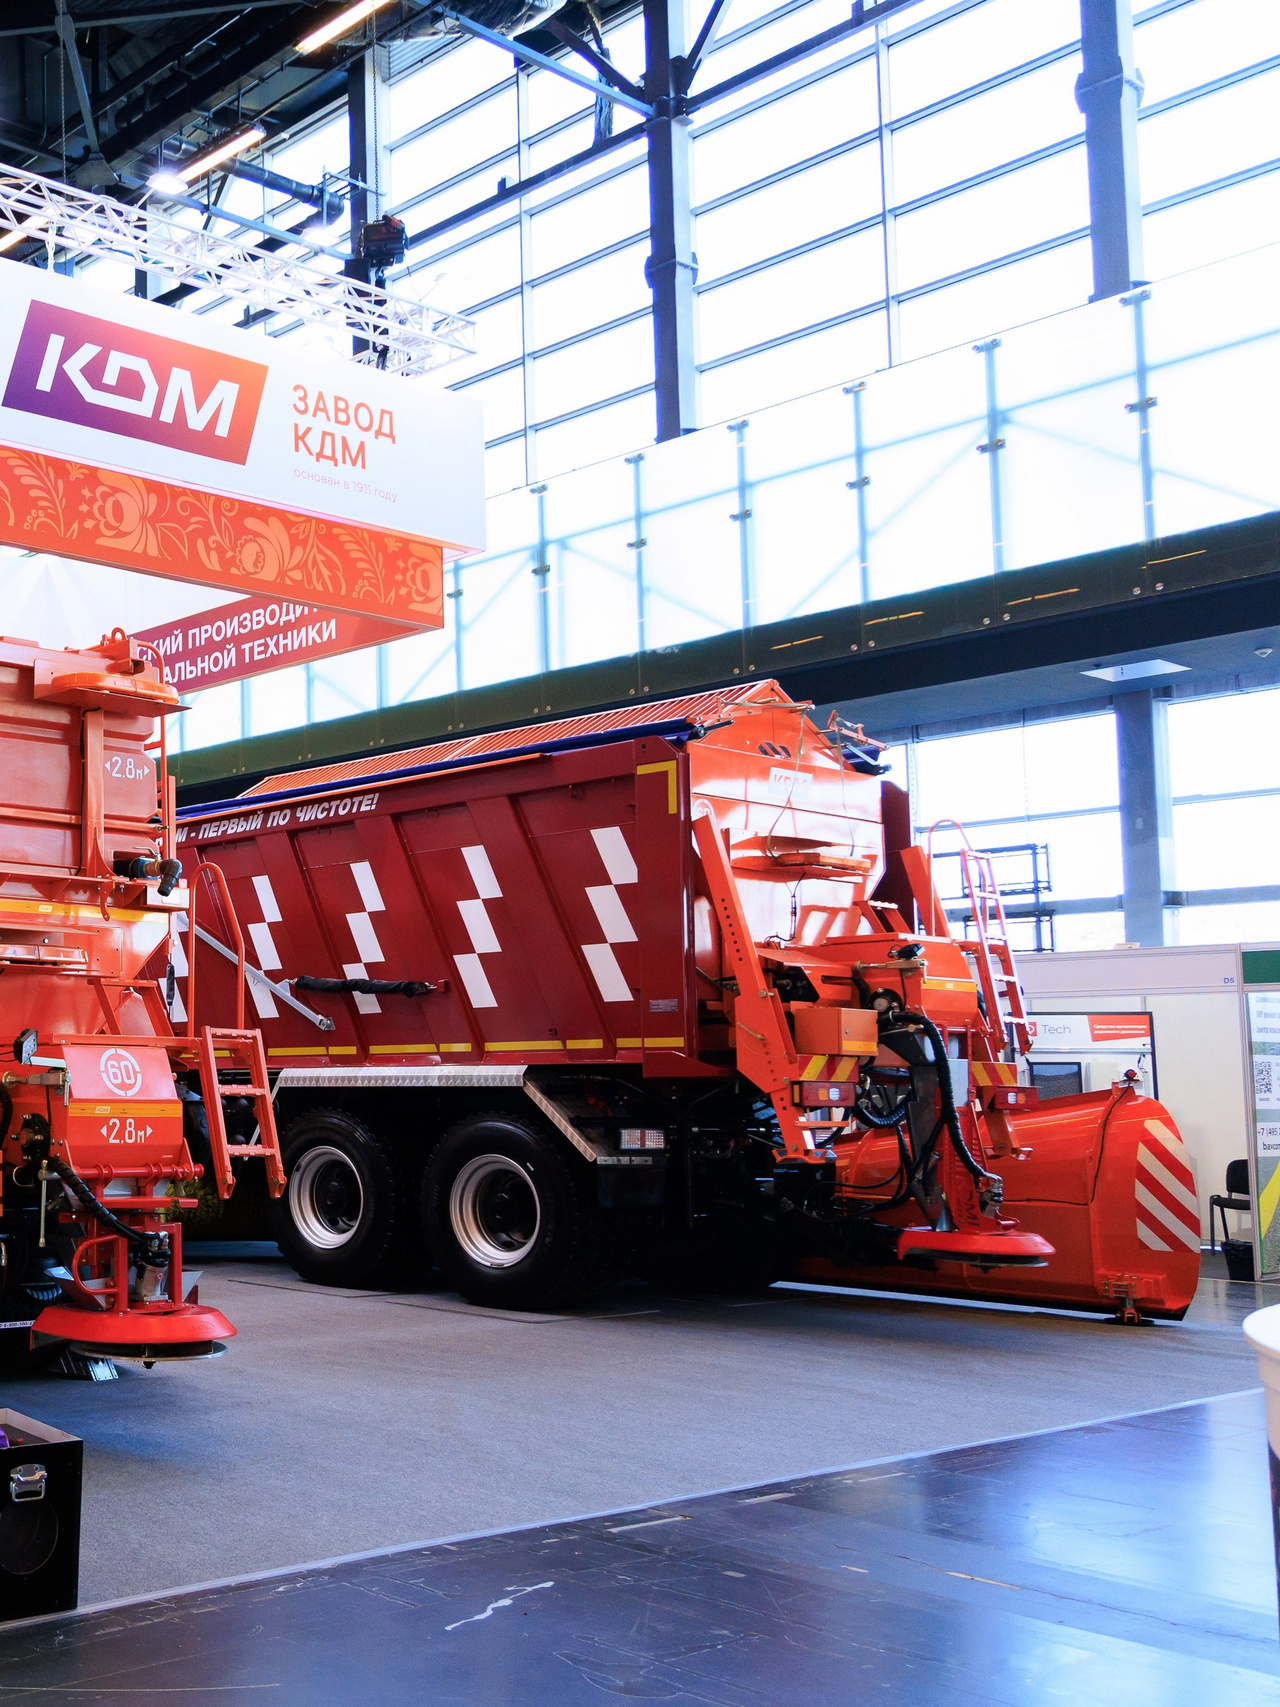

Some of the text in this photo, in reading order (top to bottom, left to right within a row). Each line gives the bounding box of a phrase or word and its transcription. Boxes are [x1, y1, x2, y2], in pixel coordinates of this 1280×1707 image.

[35, 333, 240, 438] KDM
[293, 384, 396, 444] ЗАВОД
[294, 422, 366, 470] КДМ
[294, 468, 398, 503] основан в 1911 году
[136, 602, 318, 661] СКИЙ ПРОИЗВОДИ
[163, 618, 336, 684] АЛЬНОЙ ТЕХНИКИ
[198, 810, 263, 840] ПЕРВЫЙ
[267, 808, 291, 828] ПО
[295, 793, 380, 822] ЧИСТОТЕ!
[1041, 1024, 1072, 1034] Tech
[107, 1060, 135, 1084] 60
